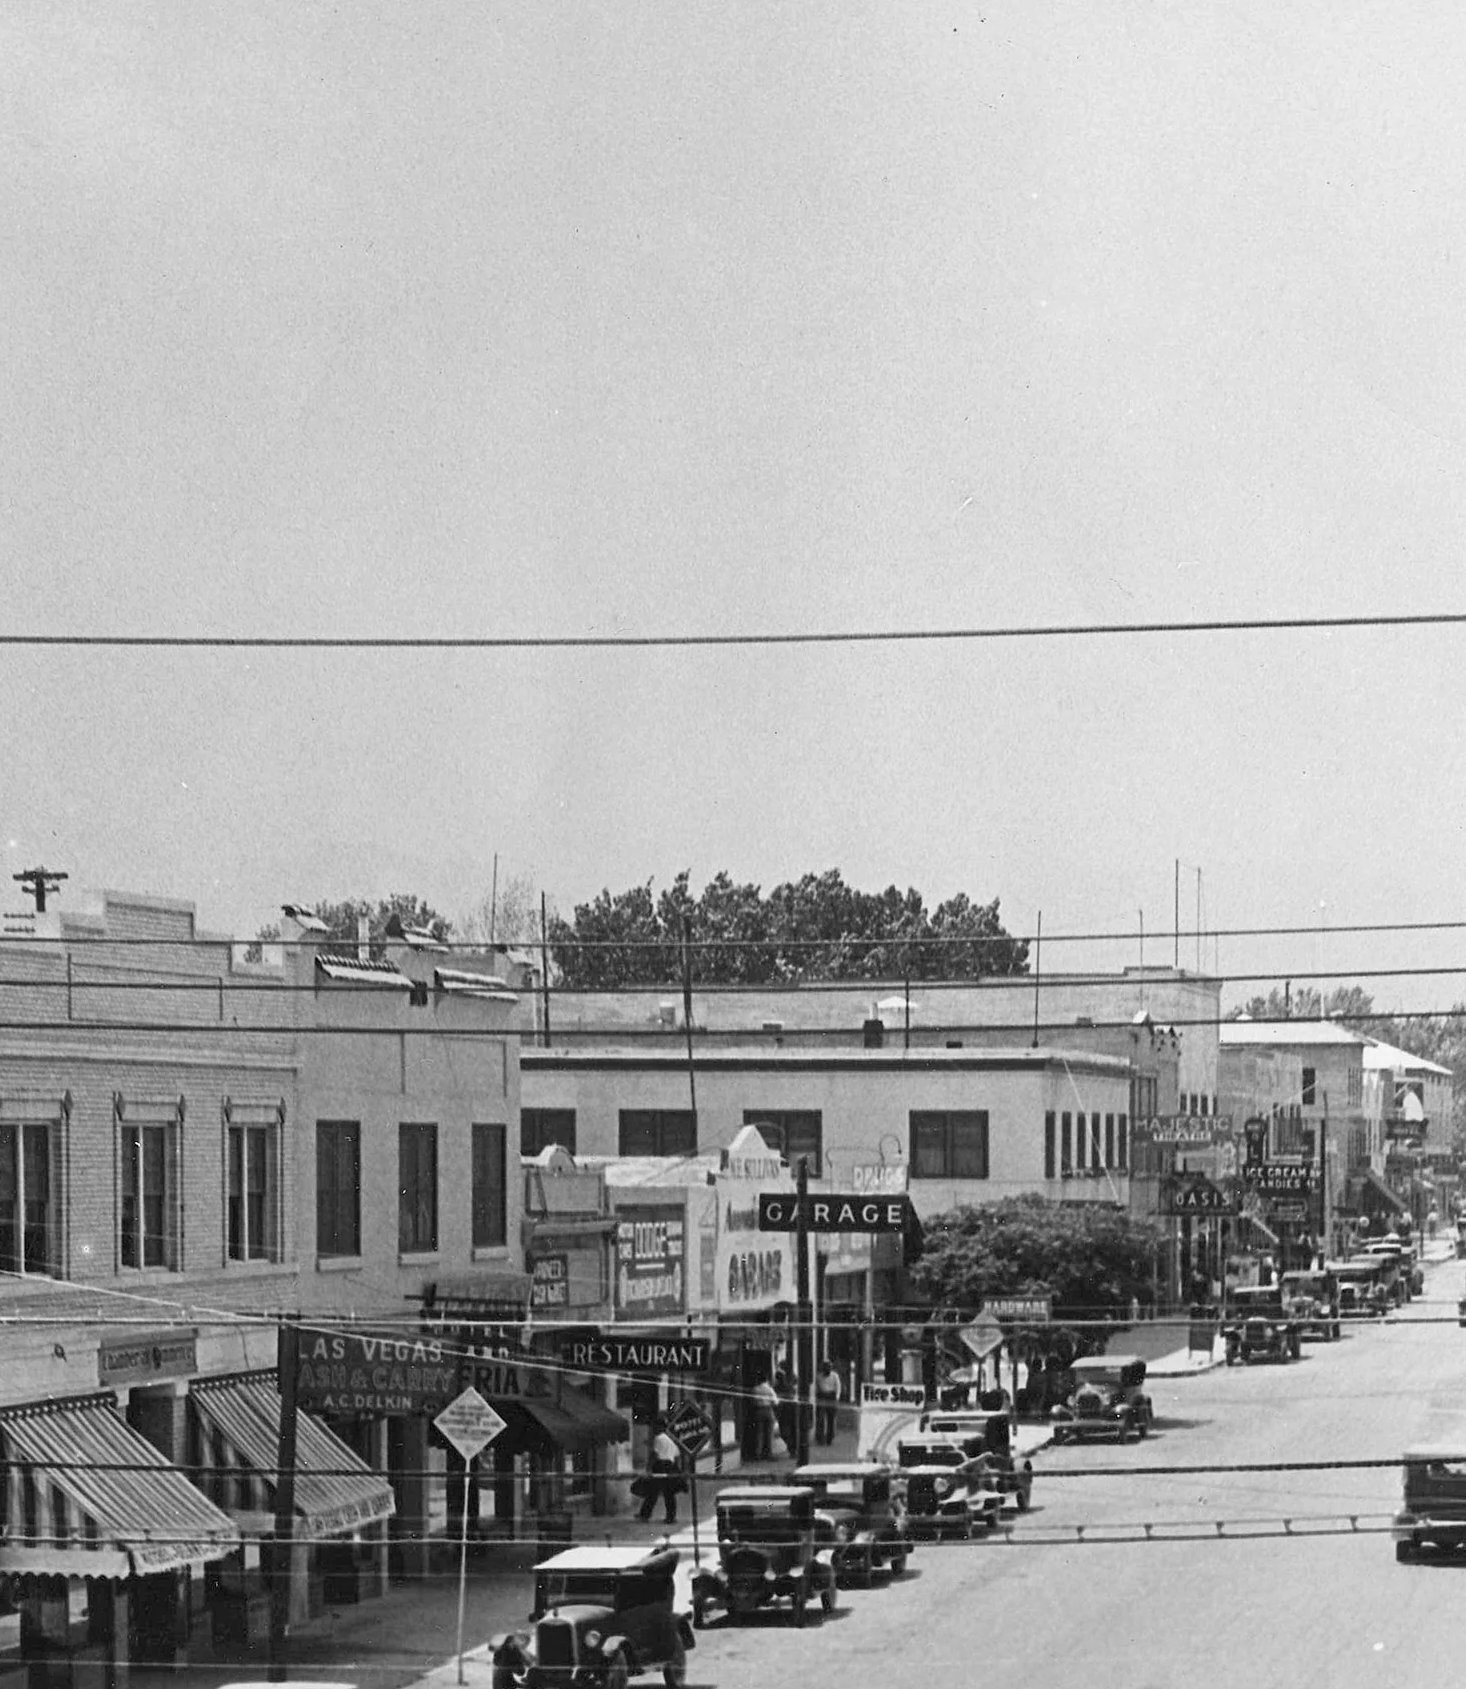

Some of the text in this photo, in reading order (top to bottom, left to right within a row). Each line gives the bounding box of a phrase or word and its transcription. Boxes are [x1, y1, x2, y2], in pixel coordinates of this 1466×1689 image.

[1135, 1117, 1230, 1132] MAJESTIC
[1175, 1191, 1231, 1207] OASIS
[362, 1337, 442, 1362] VEGAS
[573, 1342, 703, 1366] RESTAURANT
[298, 1364, 347, 1390] ASH
[372, 1367, 456, 1393] CARRY
[354, 1396, 413, 1410] DELKIN
[863, 1384, 924, 1407] Tire Shop
